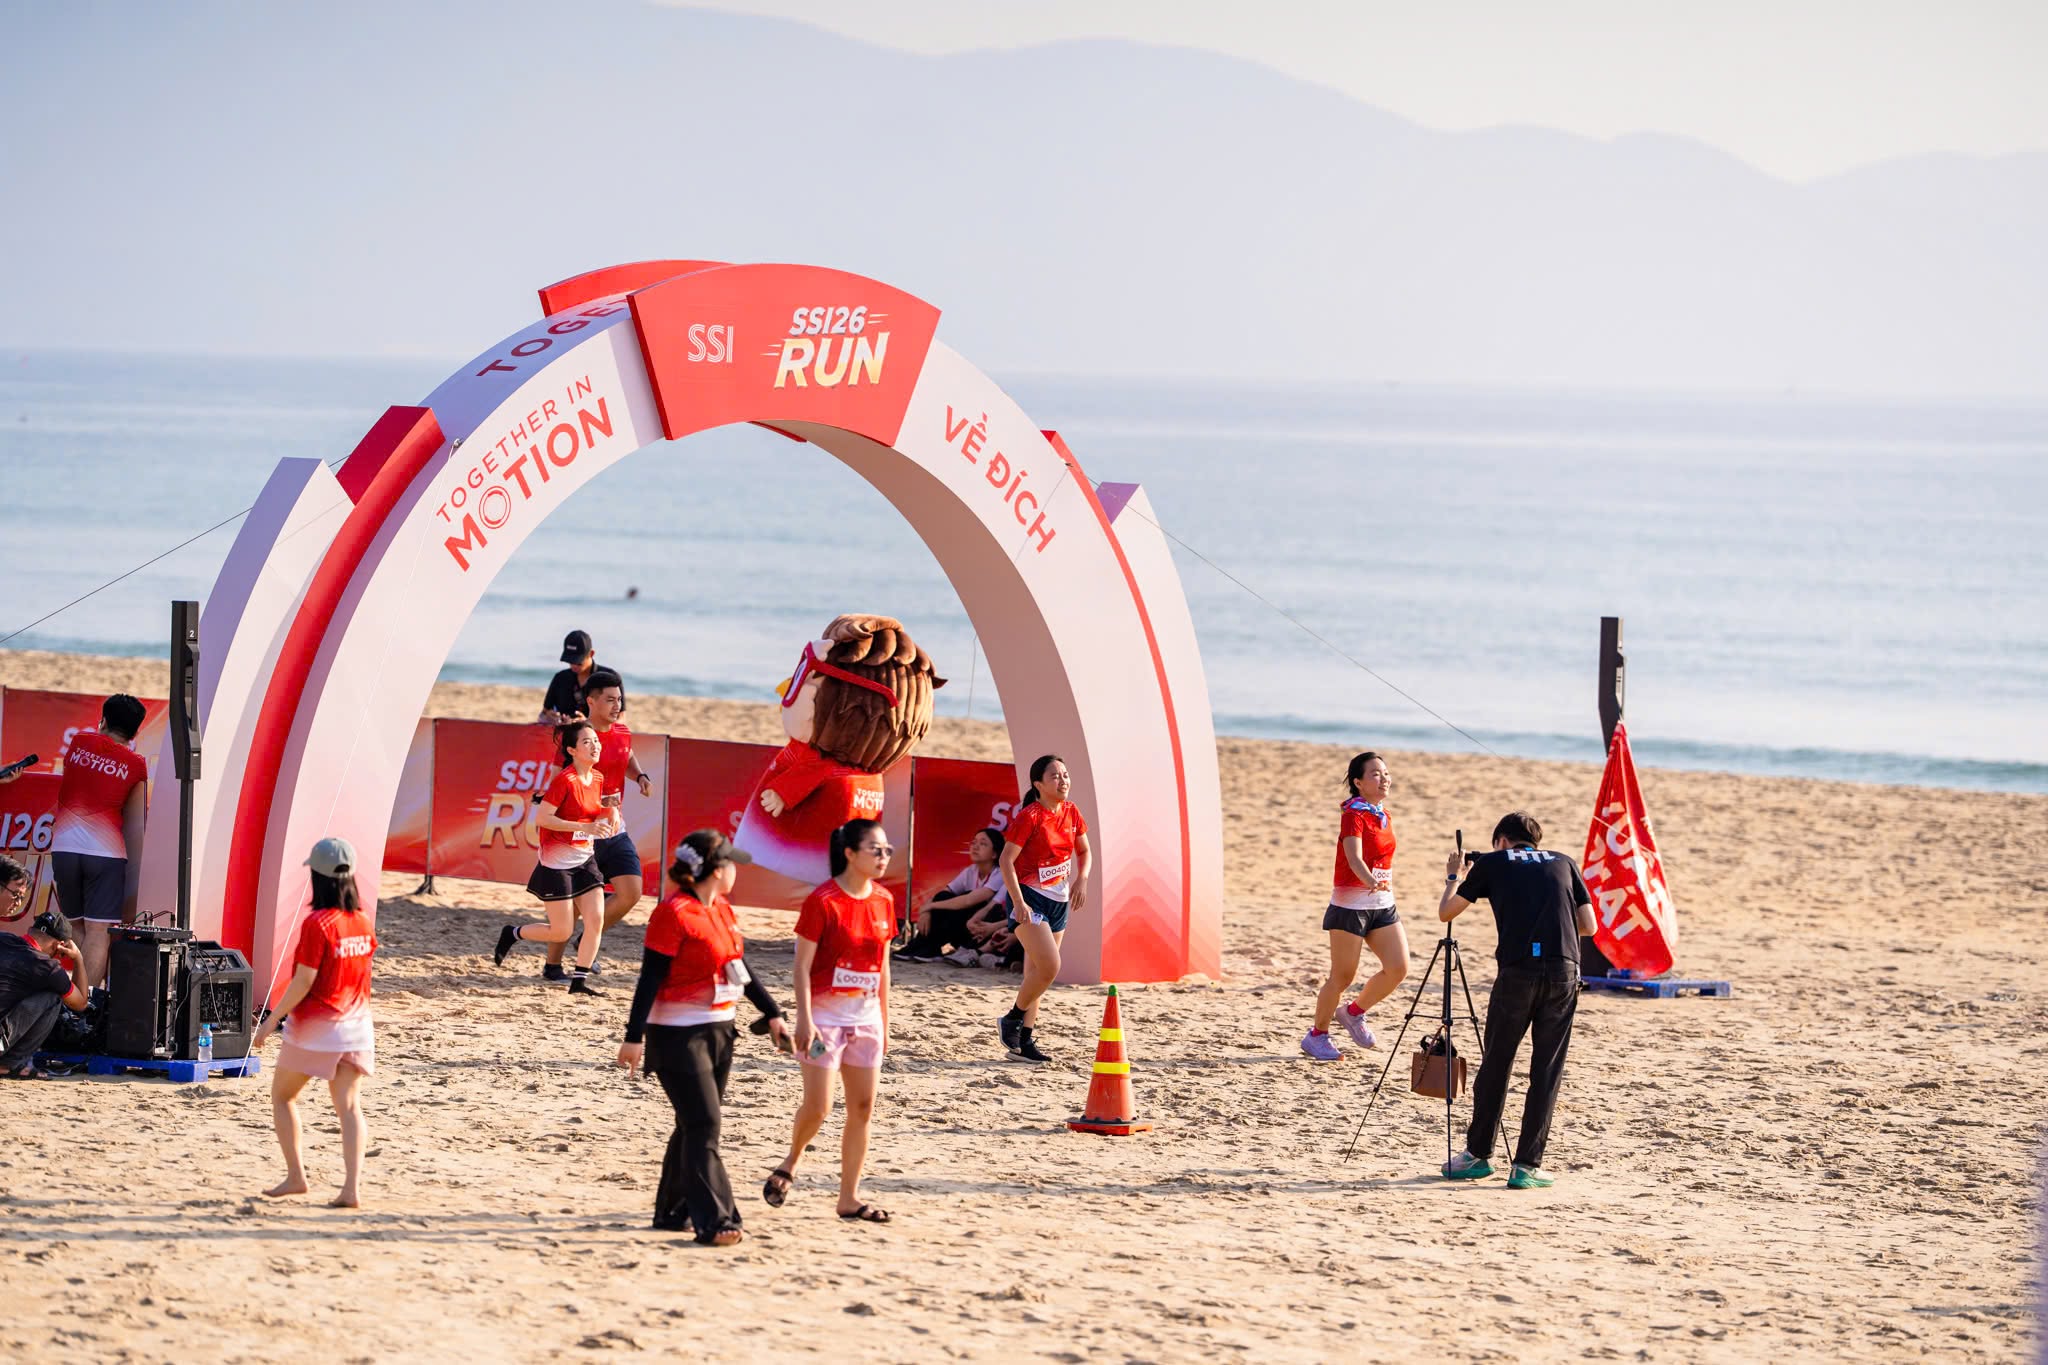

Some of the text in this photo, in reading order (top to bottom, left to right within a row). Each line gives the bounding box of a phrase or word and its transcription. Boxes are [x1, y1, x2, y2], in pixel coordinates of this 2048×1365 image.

[789, 305, 868, 336] SSI26
[687, 323, 734, 363] SSI
[773, 331, 890, 389] RUN
[436, 375, 593, 523] TOGETHER IN
[444, 396, 614, 573] MOTION
[945, 404, 1057, 554] VỀ ĐÍCH
[188, 629, 195, 638] 2
[70, 751, 129, 780] MOTION
[76, 747, 129, 770] TOGETHER IN
